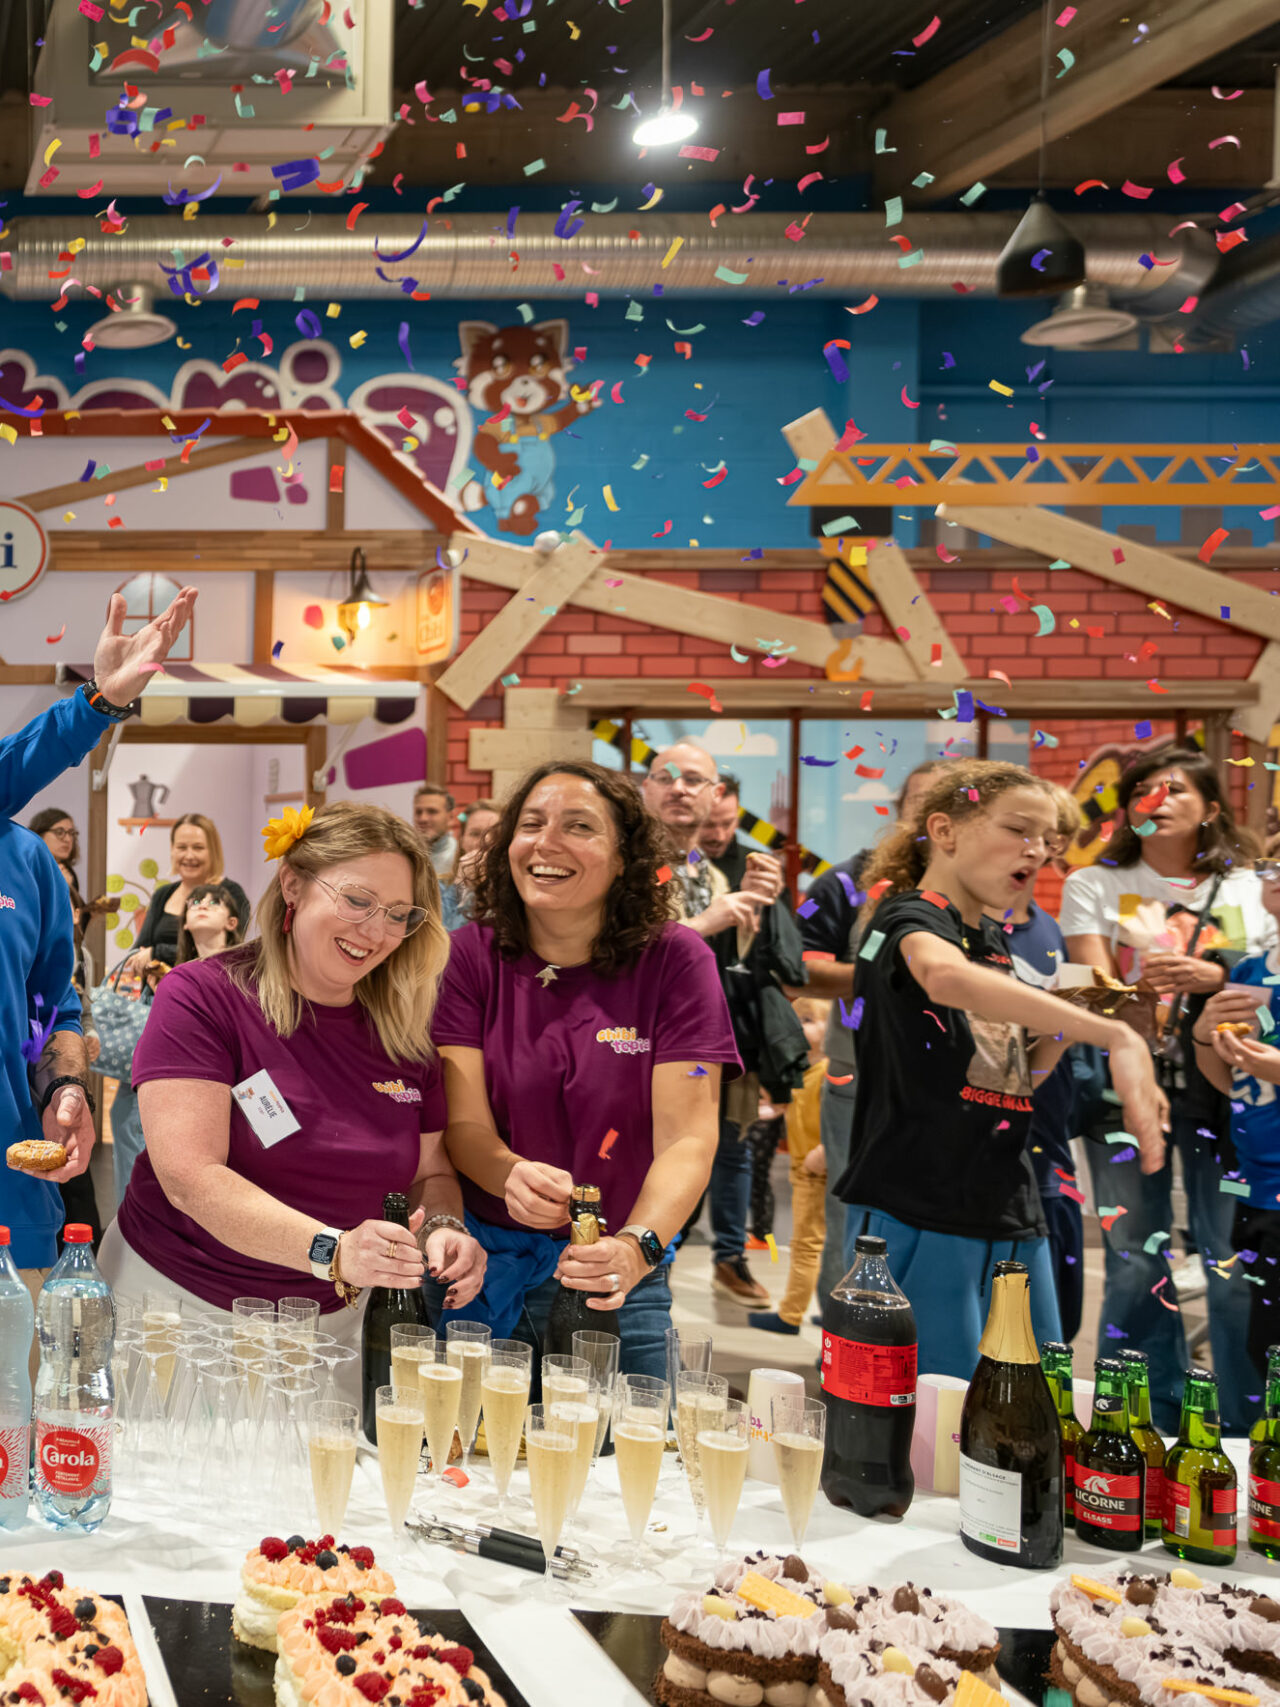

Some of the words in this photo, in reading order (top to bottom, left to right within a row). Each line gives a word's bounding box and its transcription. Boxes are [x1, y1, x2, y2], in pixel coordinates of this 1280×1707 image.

[597, 1027, 637, 1042] chibi
[611, 1038, 651, 1055] topia
[43, 1444, 96, 1467] Carola
[1075, 1487, 1126, 1511] LICORNE
[1083, 1511, 1113, 1525] ELSASS
